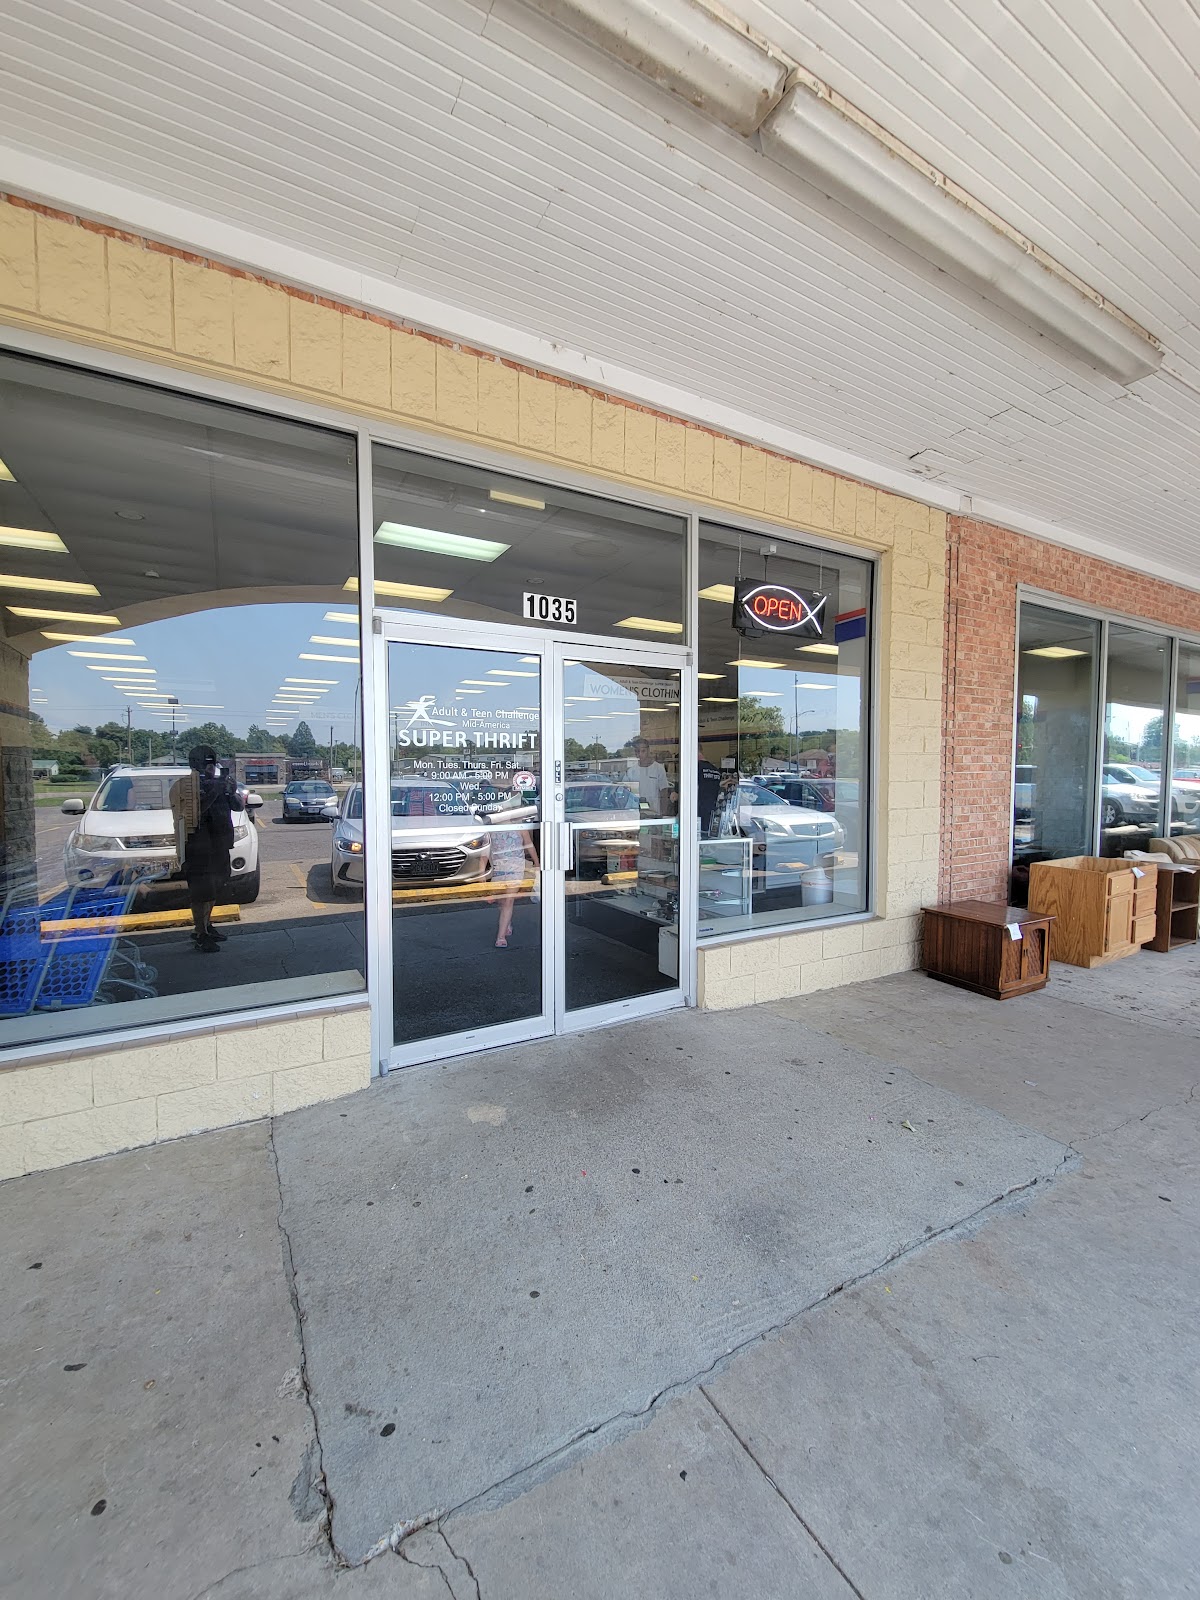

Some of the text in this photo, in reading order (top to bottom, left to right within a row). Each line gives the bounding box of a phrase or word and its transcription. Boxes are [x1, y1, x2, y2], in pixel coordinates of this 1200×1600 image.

[527, 595, 575, 623] 1035
[754, 595, 802, 621] OPEN
[590, 684, 639, 696] WOMEN'S
[432, 706, 540, 721] Adult & Teen Challenge
[462, 720, 510, 729] Mid-America
[399, 730, 538, 748] SUPER THRIFT
[414, 760, 435, 769] Mon.
[437, 760, 460, 769] Tues.
[462, 760, 488, 769] Thurs.
[490, 760, 504, 769] Fri.
[460, 782, 481, 790] Wed.
[498, 792, 511, 800] PM
[438, 804, 468, 812] Closed
